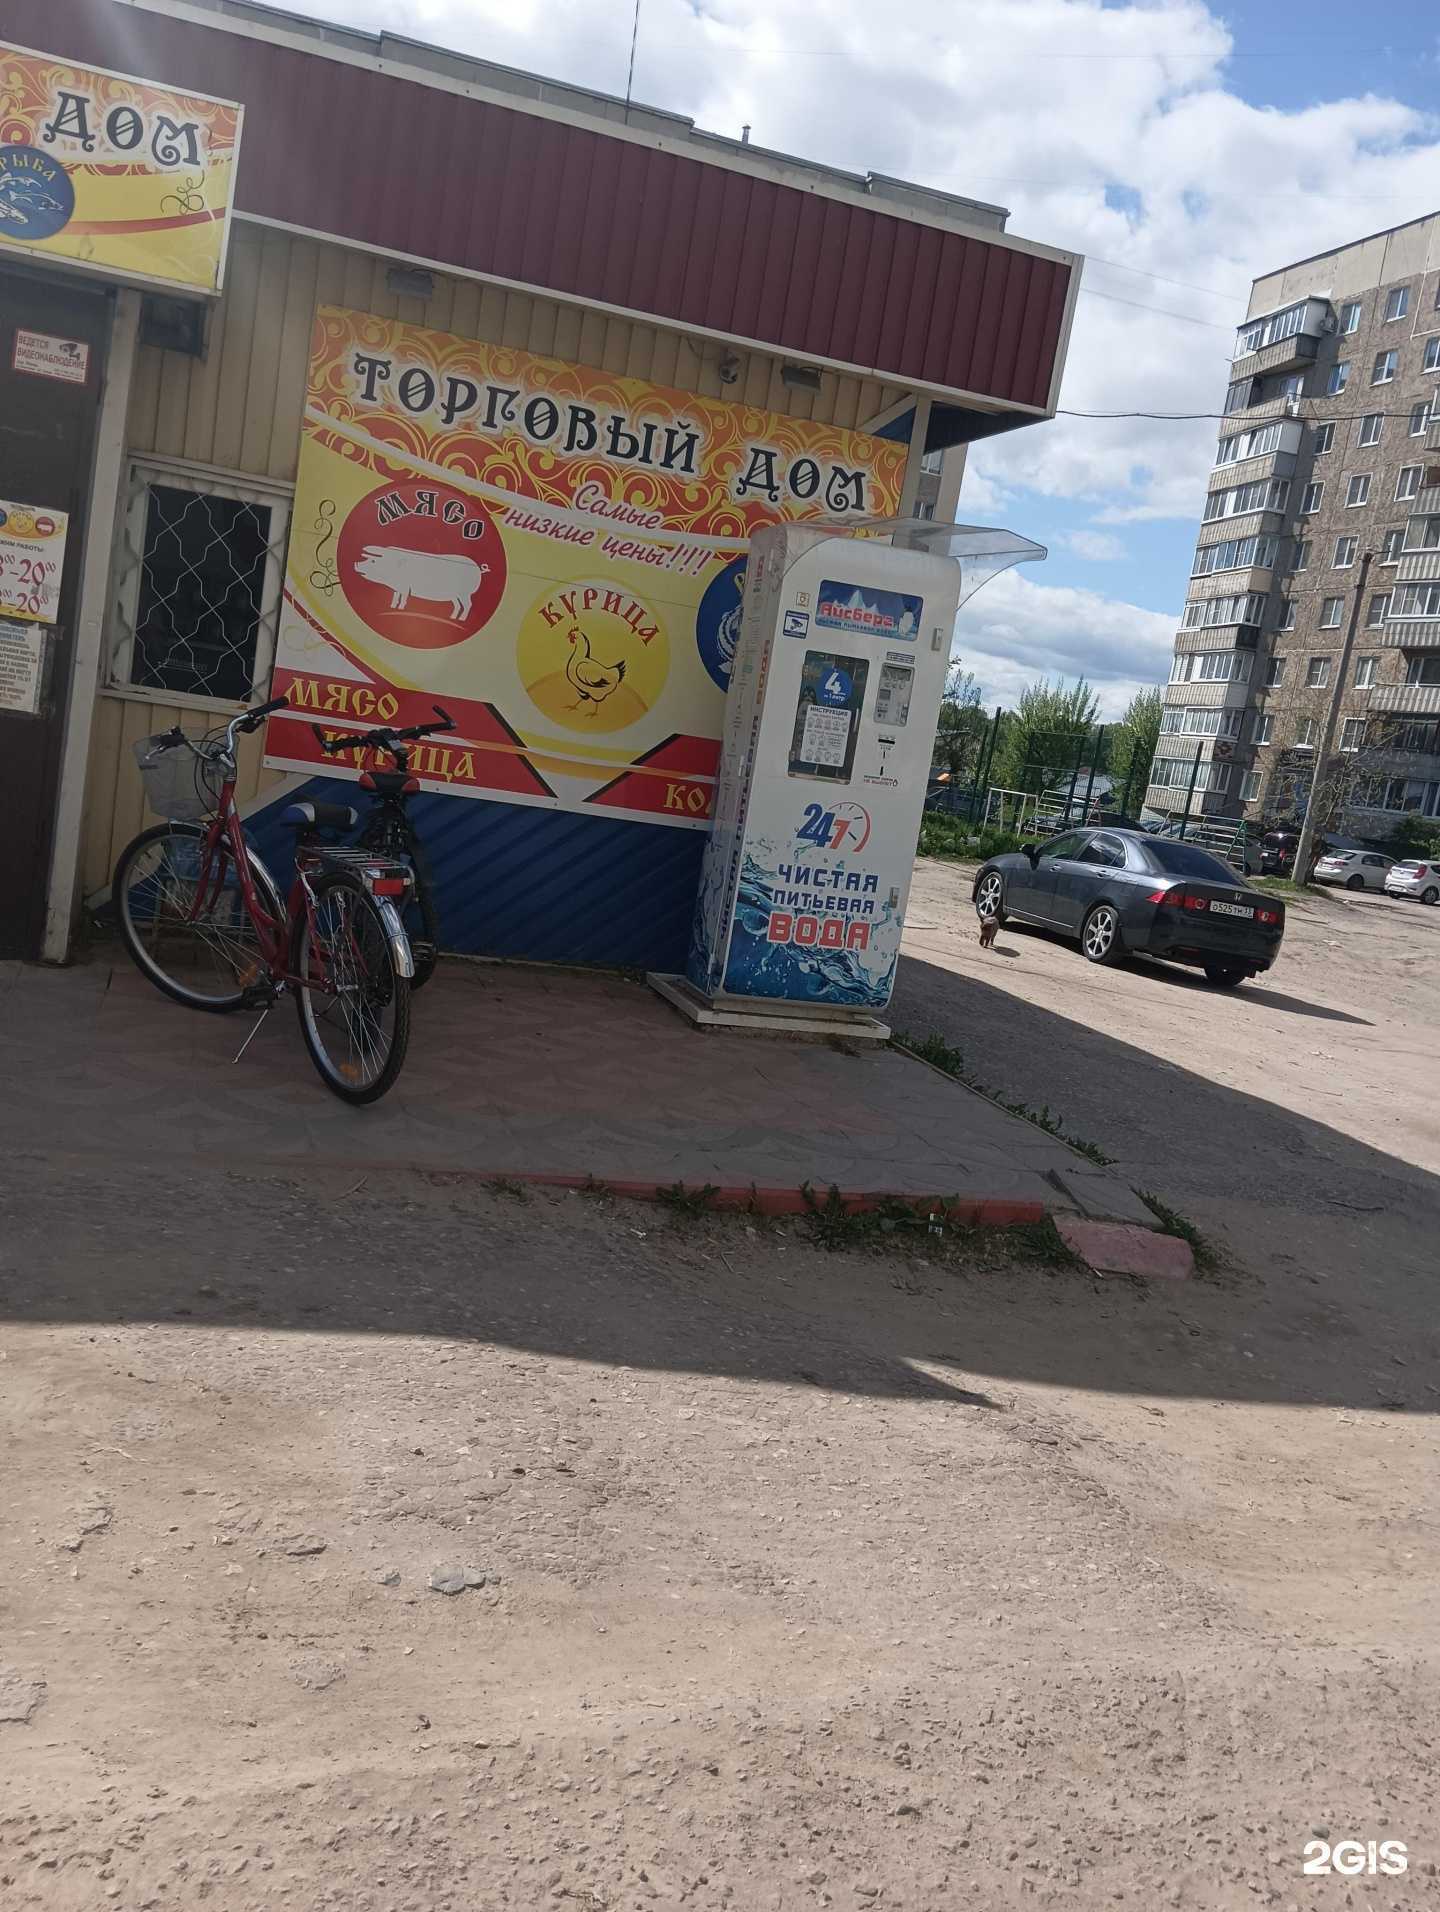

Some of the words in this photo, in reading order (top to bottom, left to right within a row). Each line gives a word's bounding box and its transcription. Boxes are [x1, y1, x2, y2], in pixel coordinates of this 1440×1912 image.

[43, 91, 200, 166] ДОМ
[354, 353, 699, 473] ТОРГОВЫЙ
[736, 448, 866, 512] ДОМ
[375, 490, 485, 540] МЯСО
[575, 484, 661, 530] Самые
[504, 509, 594, 546] низкие
[601, 542, 713, 576] цены!!!
[537, 588, 661, 647] КУРИЦА
[820, 602, 895, 627] Айсберг
[284, 677, 399, 721] МЯСО
[778, 864, 879, 893] ЧИСТАЯ
[772, 890, 876, 914] ПИТЬЕВАЯ
[767, 912, 872, 951] ВОДА
